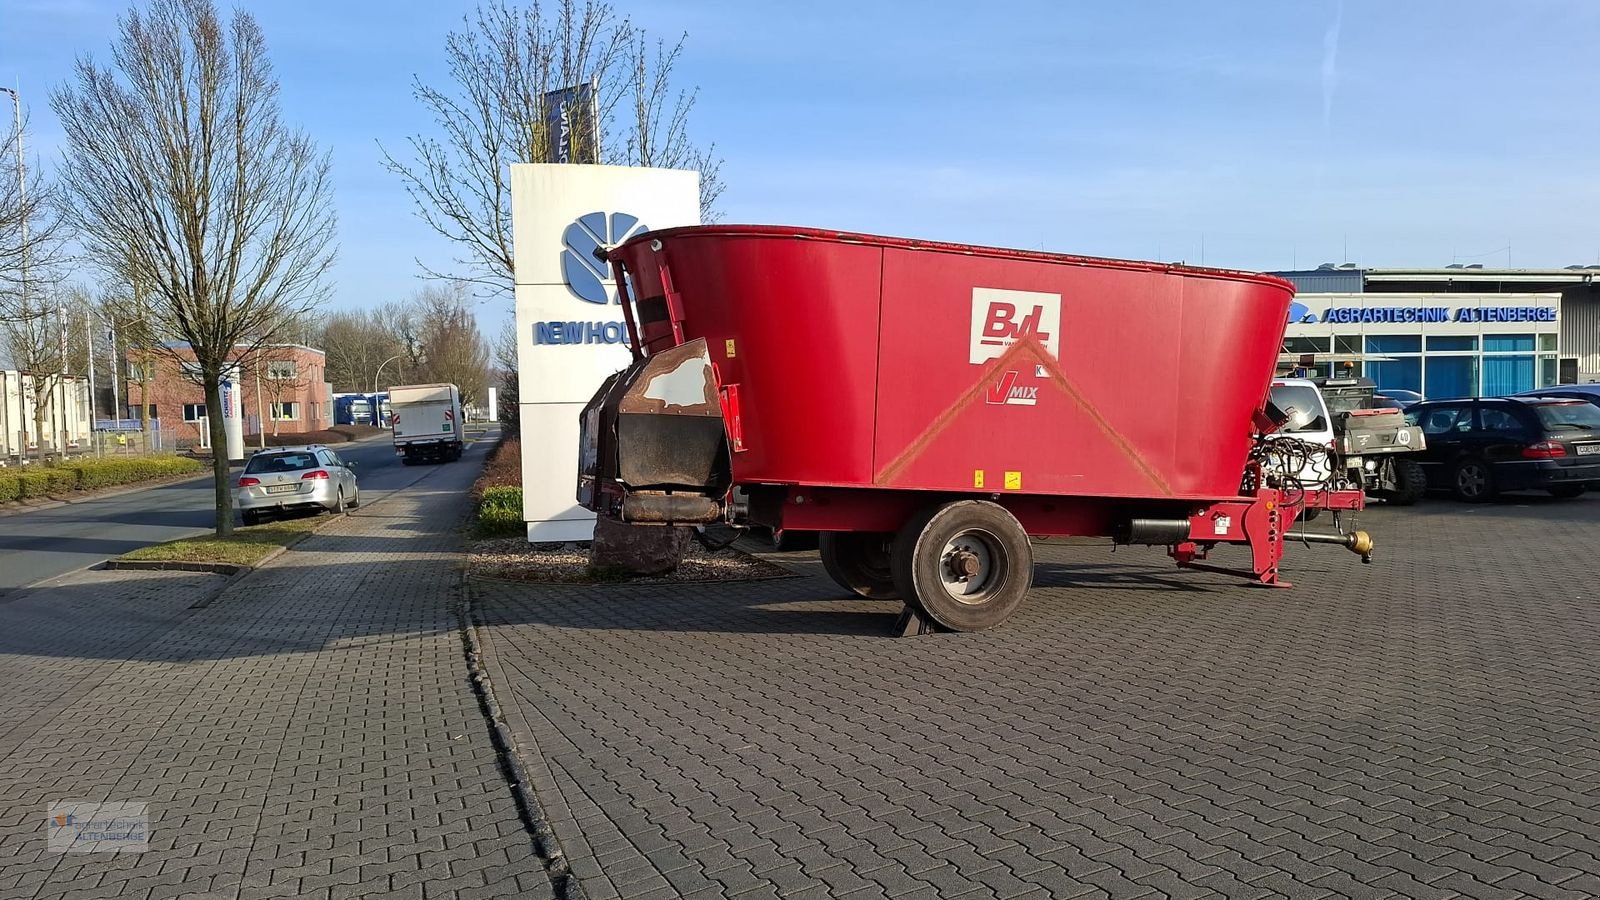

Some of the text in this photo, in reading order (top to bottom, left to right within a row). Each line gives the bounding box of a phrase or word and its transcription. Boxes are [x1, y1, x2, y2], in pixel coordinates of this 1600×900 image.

[1324, 306, 1557, 323] AGRARTECHNIK ALTENBERGE
[534, 321, 632, 345] NEW HOL
[1400, 432, 1409, 442] 40
